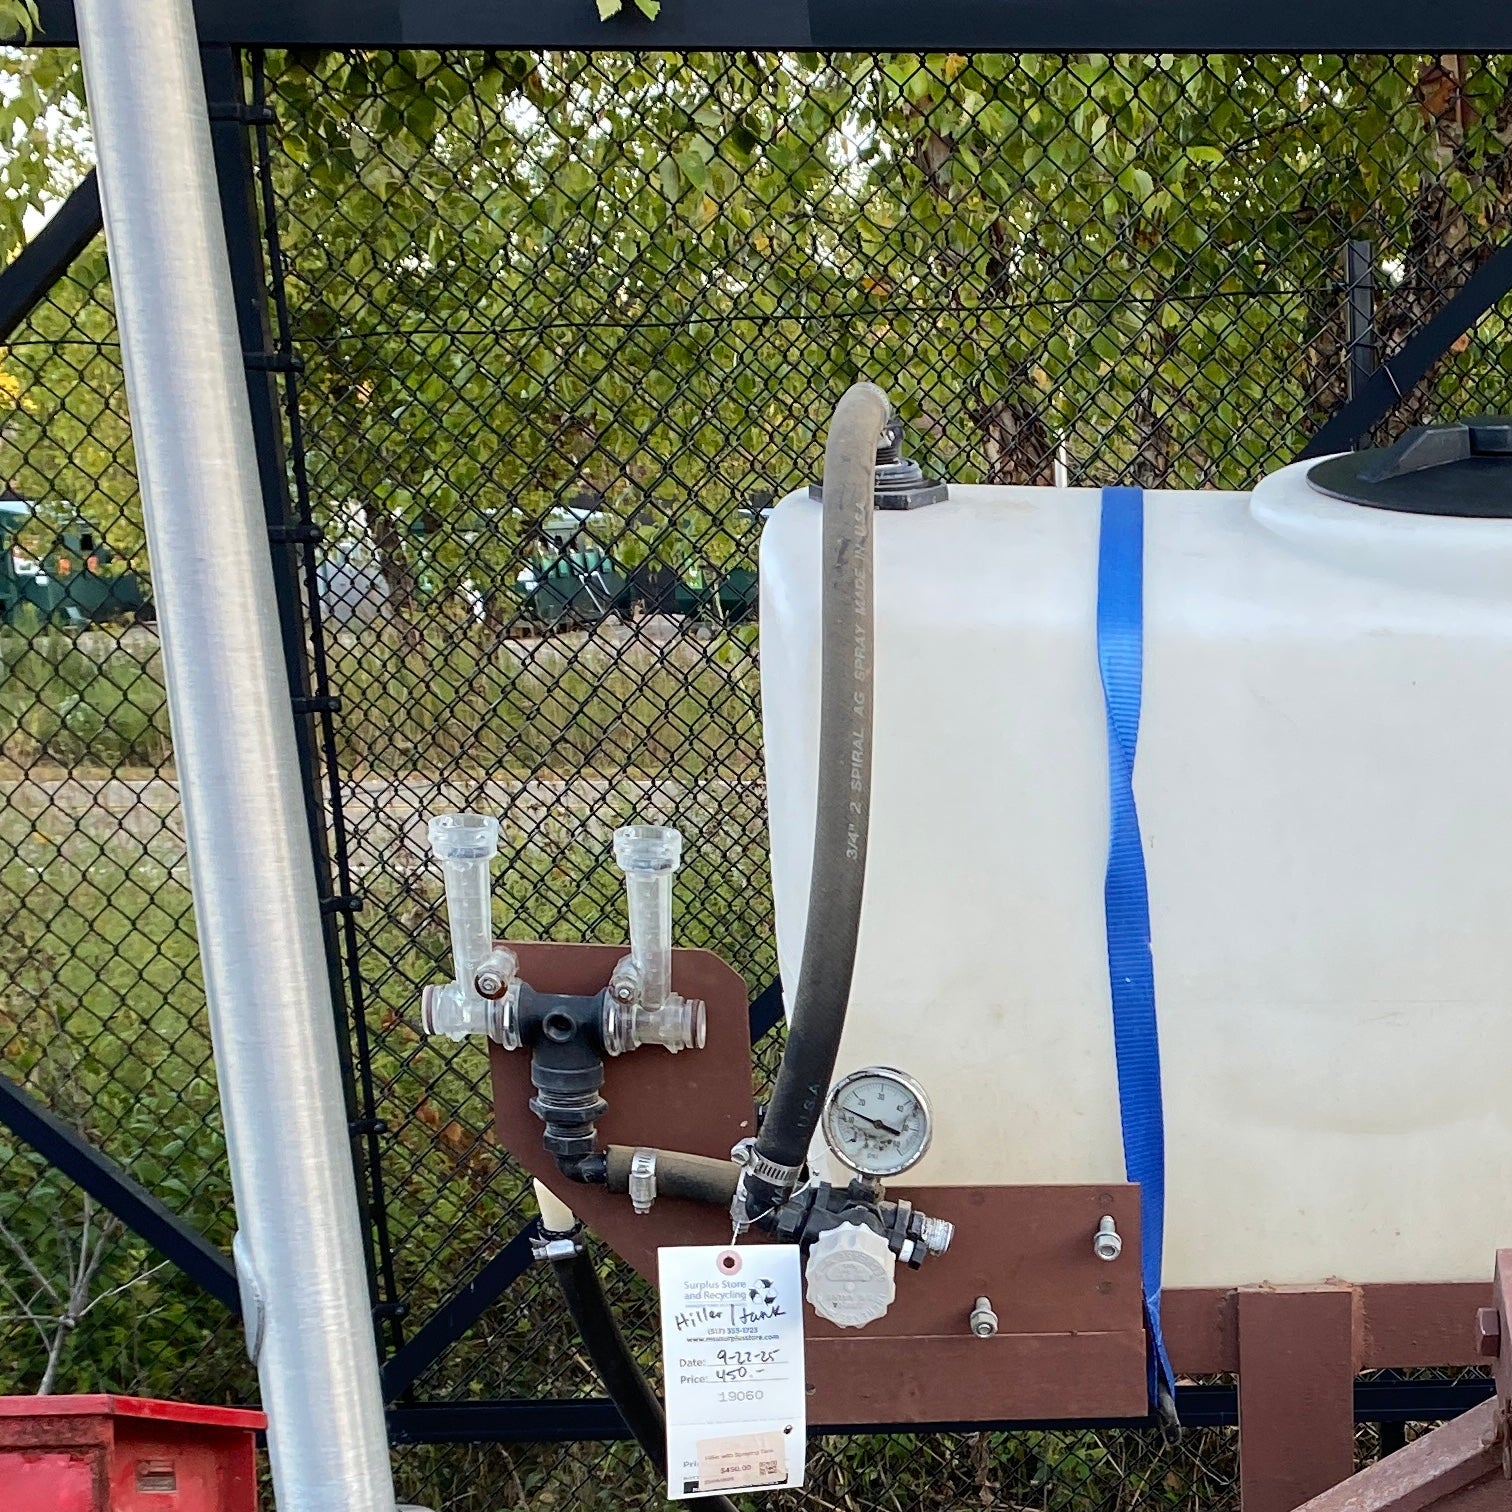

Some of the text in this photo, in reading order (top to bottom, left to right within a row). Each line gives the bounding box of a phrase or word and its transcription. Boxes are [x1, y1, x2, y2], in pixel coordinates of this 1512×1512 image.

[846, 502, 866, 861] 3/4" 2 SPIRAL AG SPRAY MADE IN USA
[684, 1279, 746, 1290] Surplus Store
[684, 1290, 746, 1301] and Recycling
[679, 1358, 706, 1368] Date:
[680, 1375, 708, 1384] Price:
[718, 1390, 764, 1403] 19060
[683, 1460, 699, 1468] Pri
